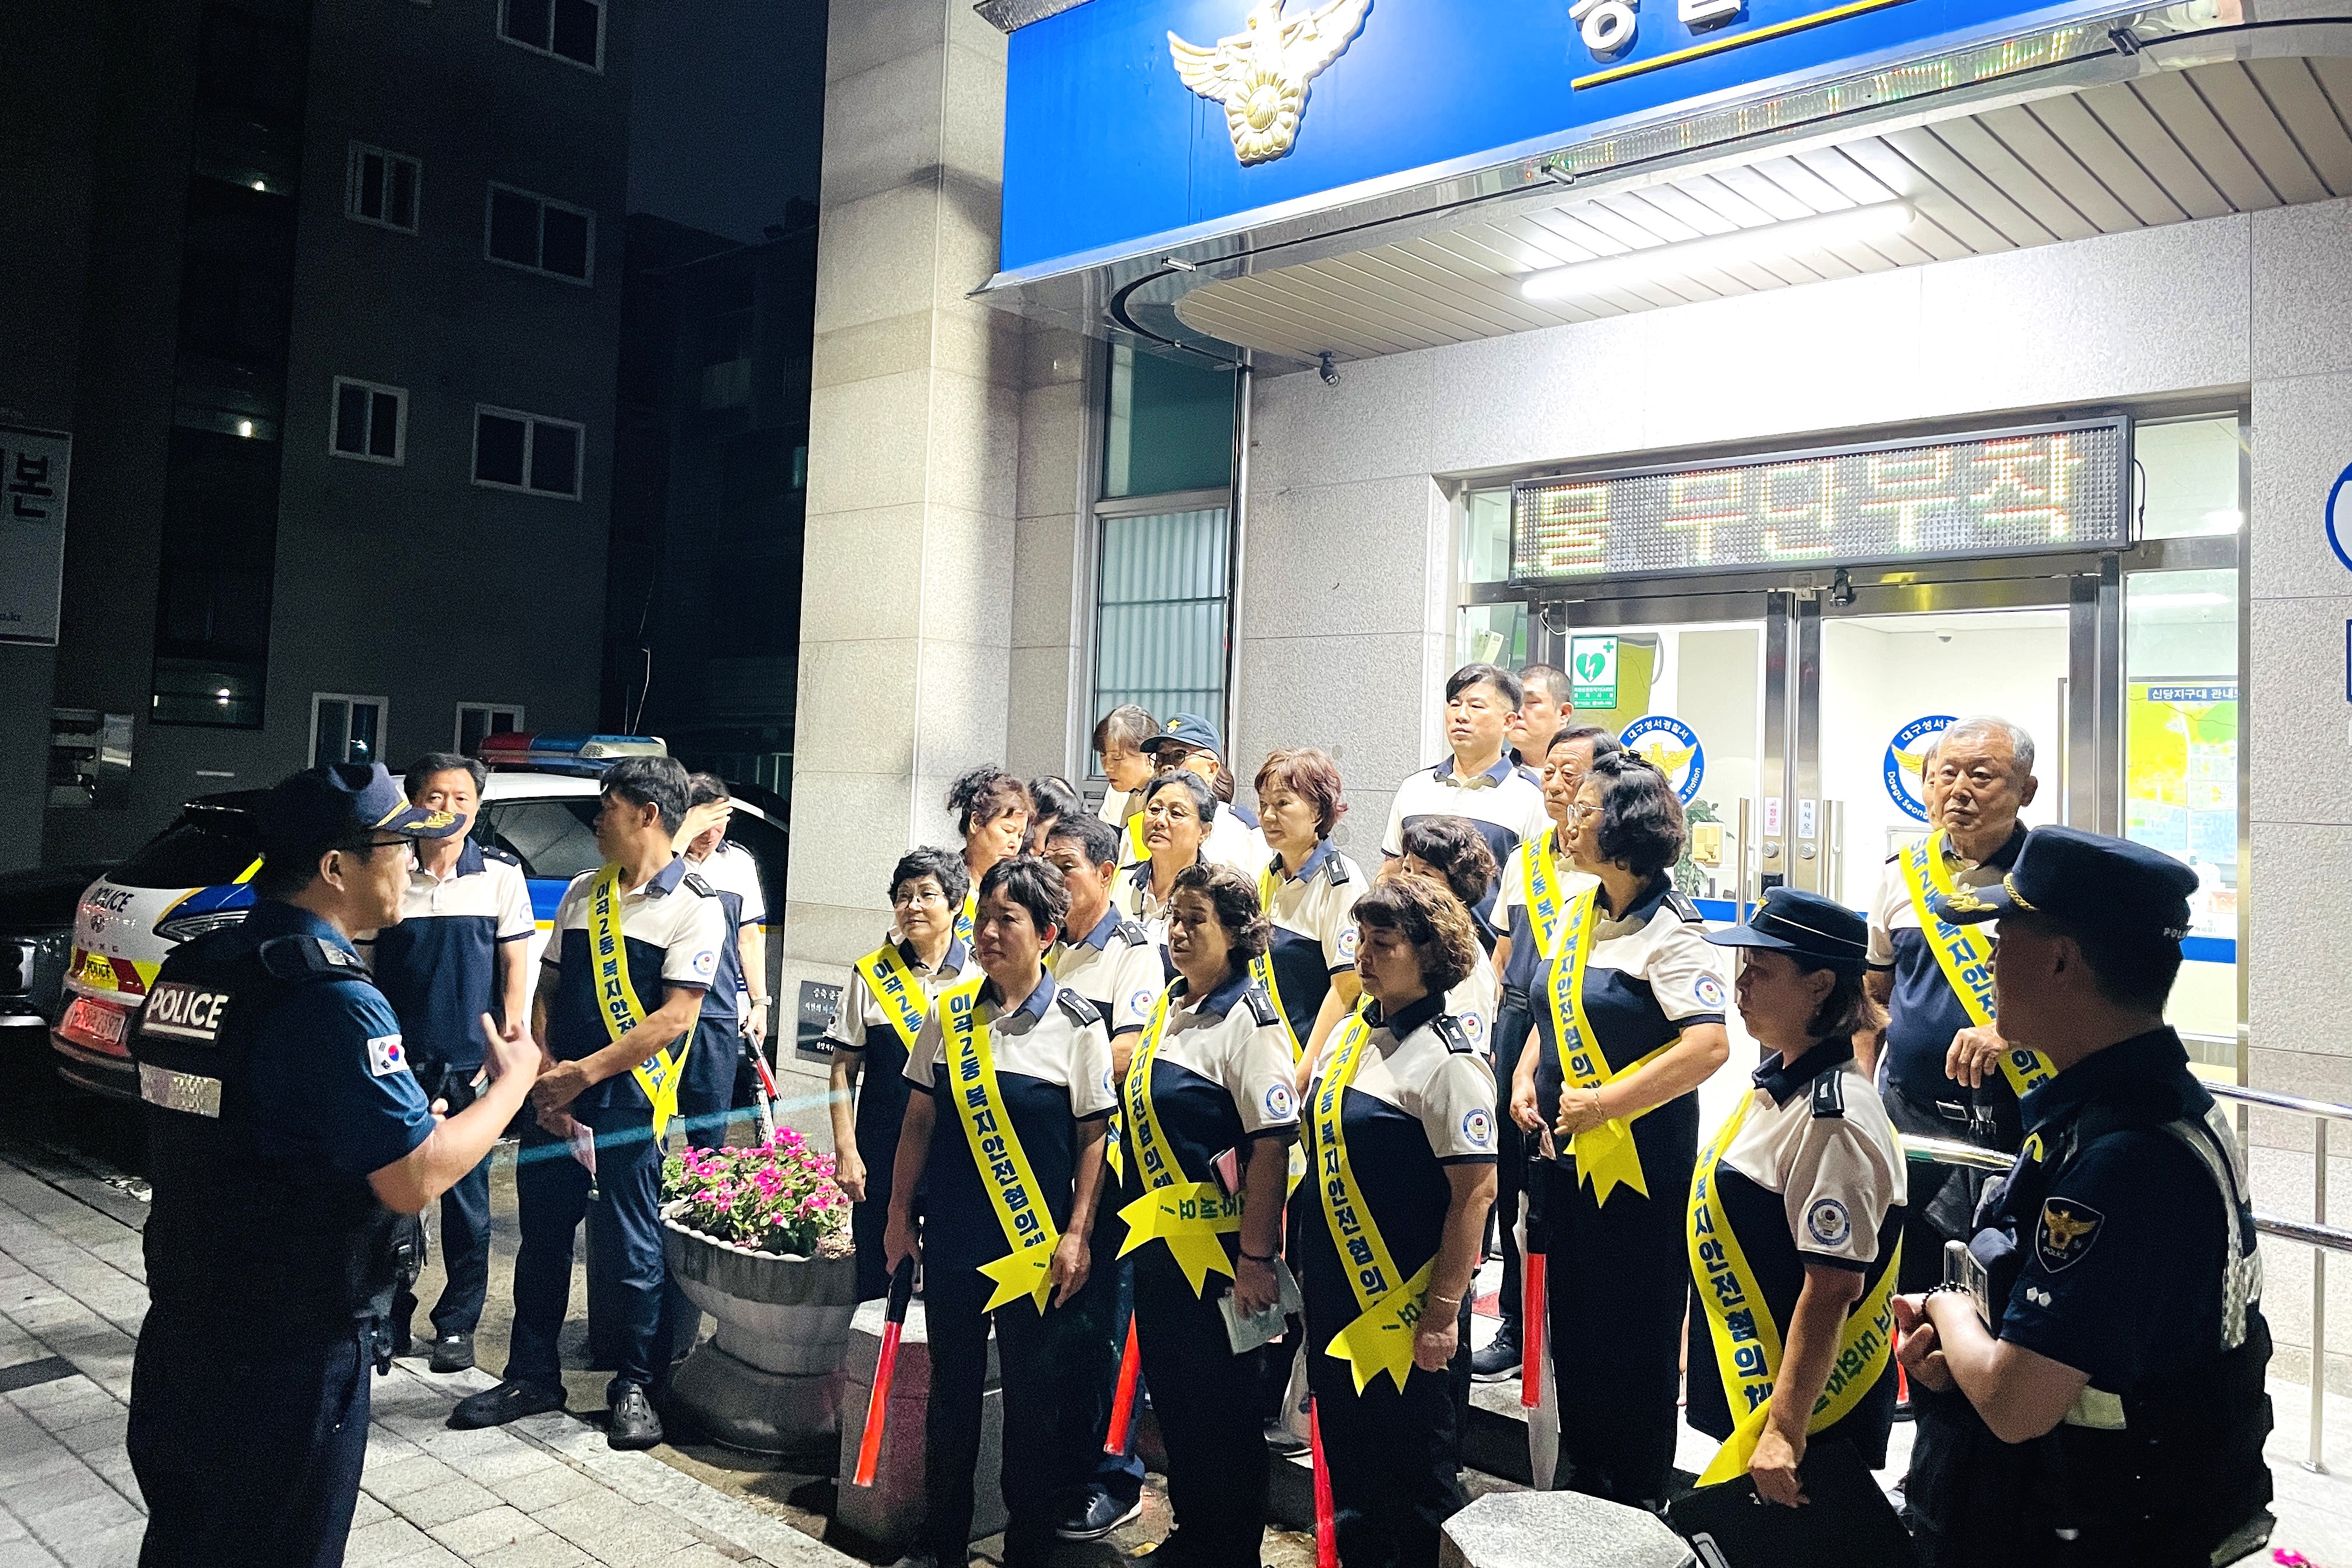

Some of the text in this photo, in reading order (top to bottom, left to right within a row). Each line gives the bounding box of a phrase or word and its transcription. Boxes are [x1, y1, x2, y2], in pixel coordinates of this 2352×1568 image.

[1, 452, 54, 519] 본
[2152, 688, 2207, 699] 신당지구대
[1627, 719, 1689, 740] 대구성서경찰서
[1685, 767, 1701, 795] Station
[1887, 771, 1903, 800] Daegu
[596, 880, 615, 956] 이곡2동
[145, 987, 229, 1029] POLICE
[873, 958, 923, 1032] 이곡2동
[950, 993, 982, 1082] 이곡2동
[1321, 1024, 1390, 1302] 이곡2동 복지안전협의
